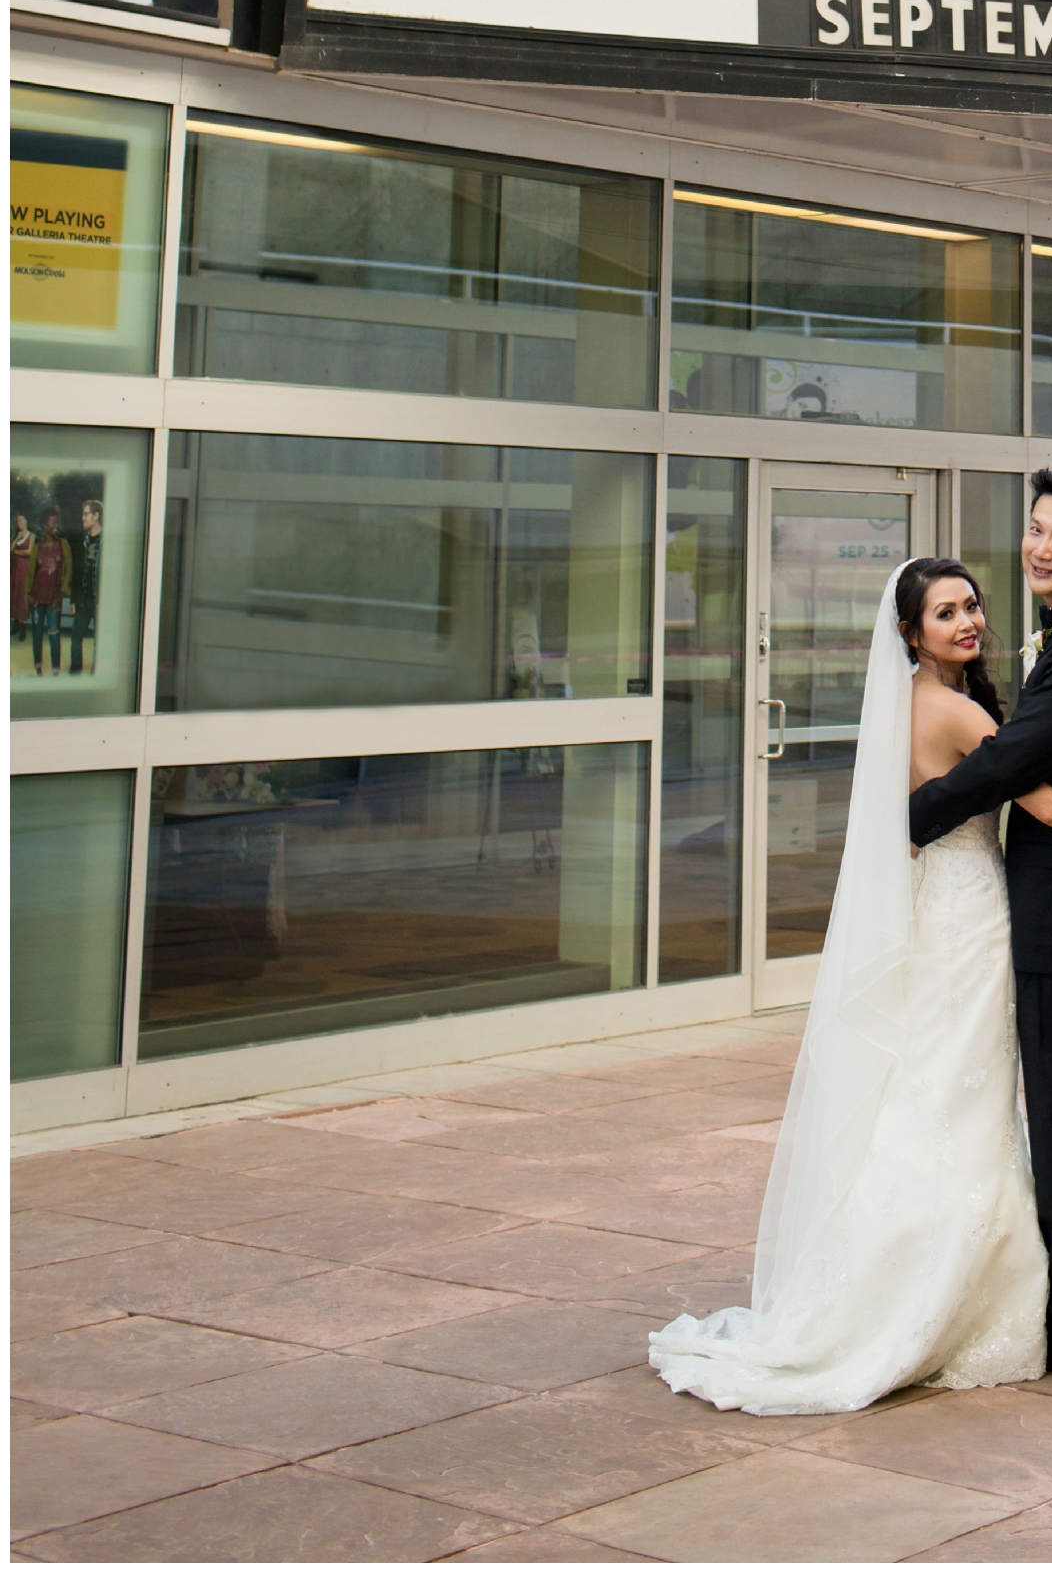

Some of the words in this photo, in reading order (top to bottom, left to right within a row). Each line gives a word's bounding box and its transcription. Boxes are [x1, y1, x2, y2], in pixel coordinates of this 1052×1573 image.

[33, 207, 105, 230] PLAYING
[16, 226, 65, 241] GALLERIA
[68, 232, 112, 246] THEATRE
[839, 546, 866, 558] SEP
[872, 547, 889, 558] 25
